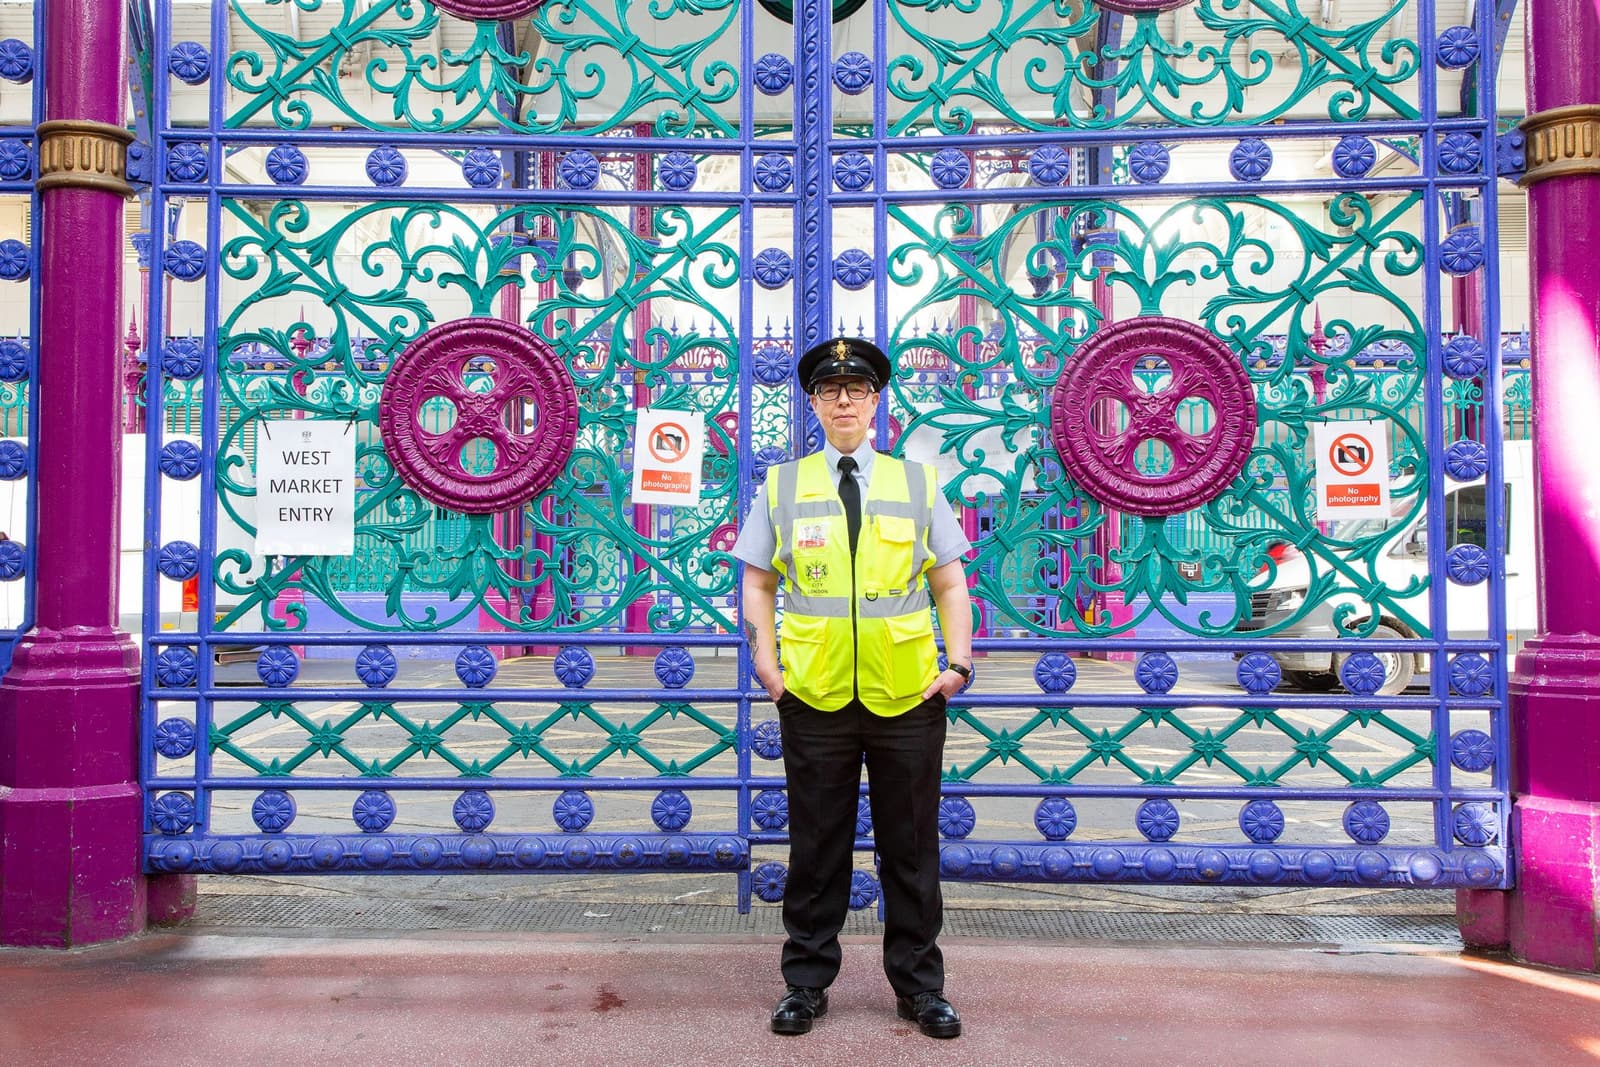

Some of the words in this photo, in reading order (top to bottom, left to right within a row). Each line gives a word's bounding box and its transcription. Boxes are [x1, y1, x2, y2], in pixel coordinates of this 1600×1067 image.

[282, 450, 331, 465] WEST
[270, 479, 343, 493] MARKET
[642, 481, 689, 490] photography
[1328, 495, 1378, 504] photography
[279, 507, 334, 522] ENTRY
